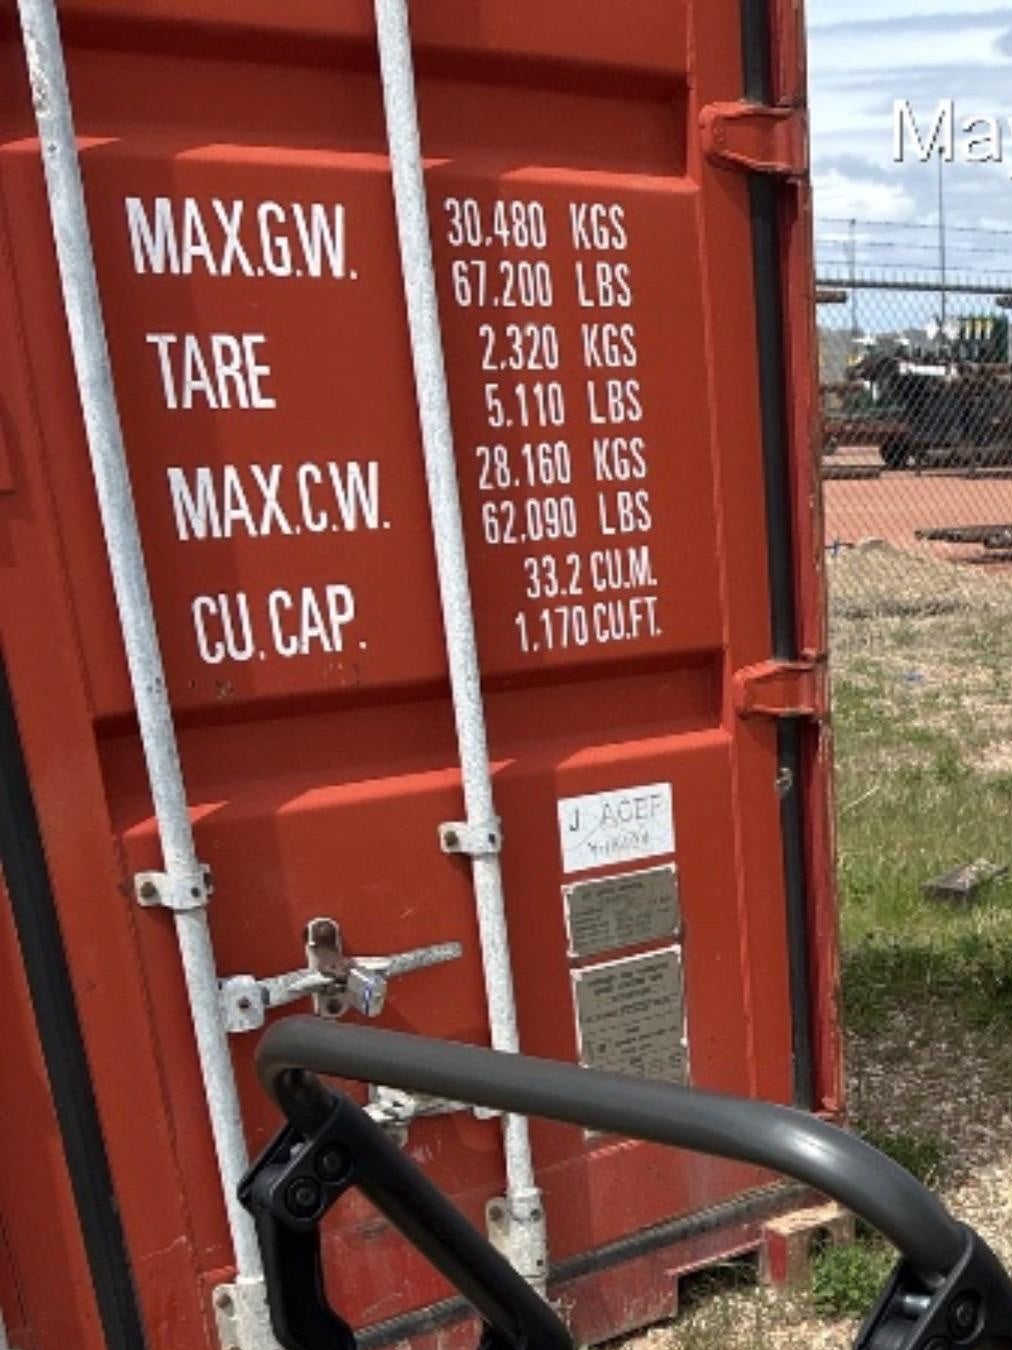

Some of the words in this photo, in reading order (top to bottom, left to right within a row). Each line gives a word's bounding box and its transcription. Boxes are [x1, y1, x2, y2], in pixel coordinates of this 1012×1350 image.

[126, 197, 358, 280] MAX.G.W.
[569, 203, 628, 251] KGS
[575, 262, 632, 308] LBS
[581, 323, 638, 368] KGS
[145, 333, 277, 409] TARE
[587, 379, 643, 425] LBS
[593, 436, 647, 481] KGS
[167, 461, 391, 541] MAX.C.W.
[598, 490, 652, 536] LBS
[523, 553, 583, 599] 33.2
[589, 545, 658, 592] CU.M.
[592, 596, 662, 643] CU.FT.
